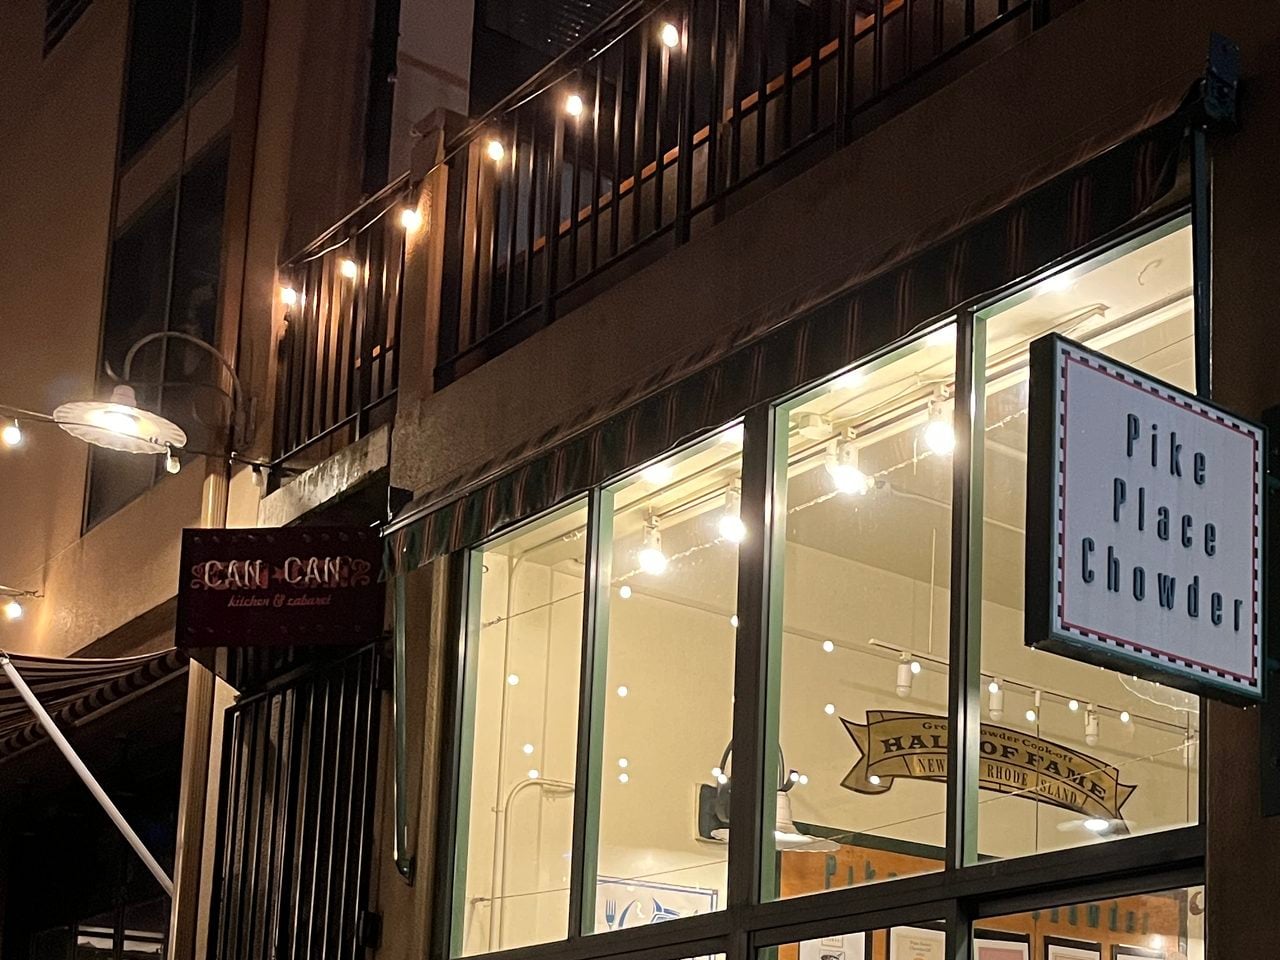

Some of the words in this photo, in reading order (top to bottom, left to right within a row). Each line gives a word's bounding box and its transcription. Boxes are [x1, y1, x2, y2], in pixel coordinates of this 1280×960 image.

[1126, 413, 1206, 485] Pike
[1113, 477, 1217, 557] Place
[204, 559, 266, 589] CAN
[284, 556, 344, 585] CAN
[1081, 537, 1243, 632] Chowder
[228, 595, 269, 607] kitchen
[881, 735, 948, 753] HAL
[980, 741, 1019, 761] OF
[1025, 749, 1107, 800] FAME
[922, 721, 948, 732] Gre
[980, 727, 1020, 745] owder
[1022, 738, 1073, 763] Cook-off
[987, 764, 1028, 786] RHODE
